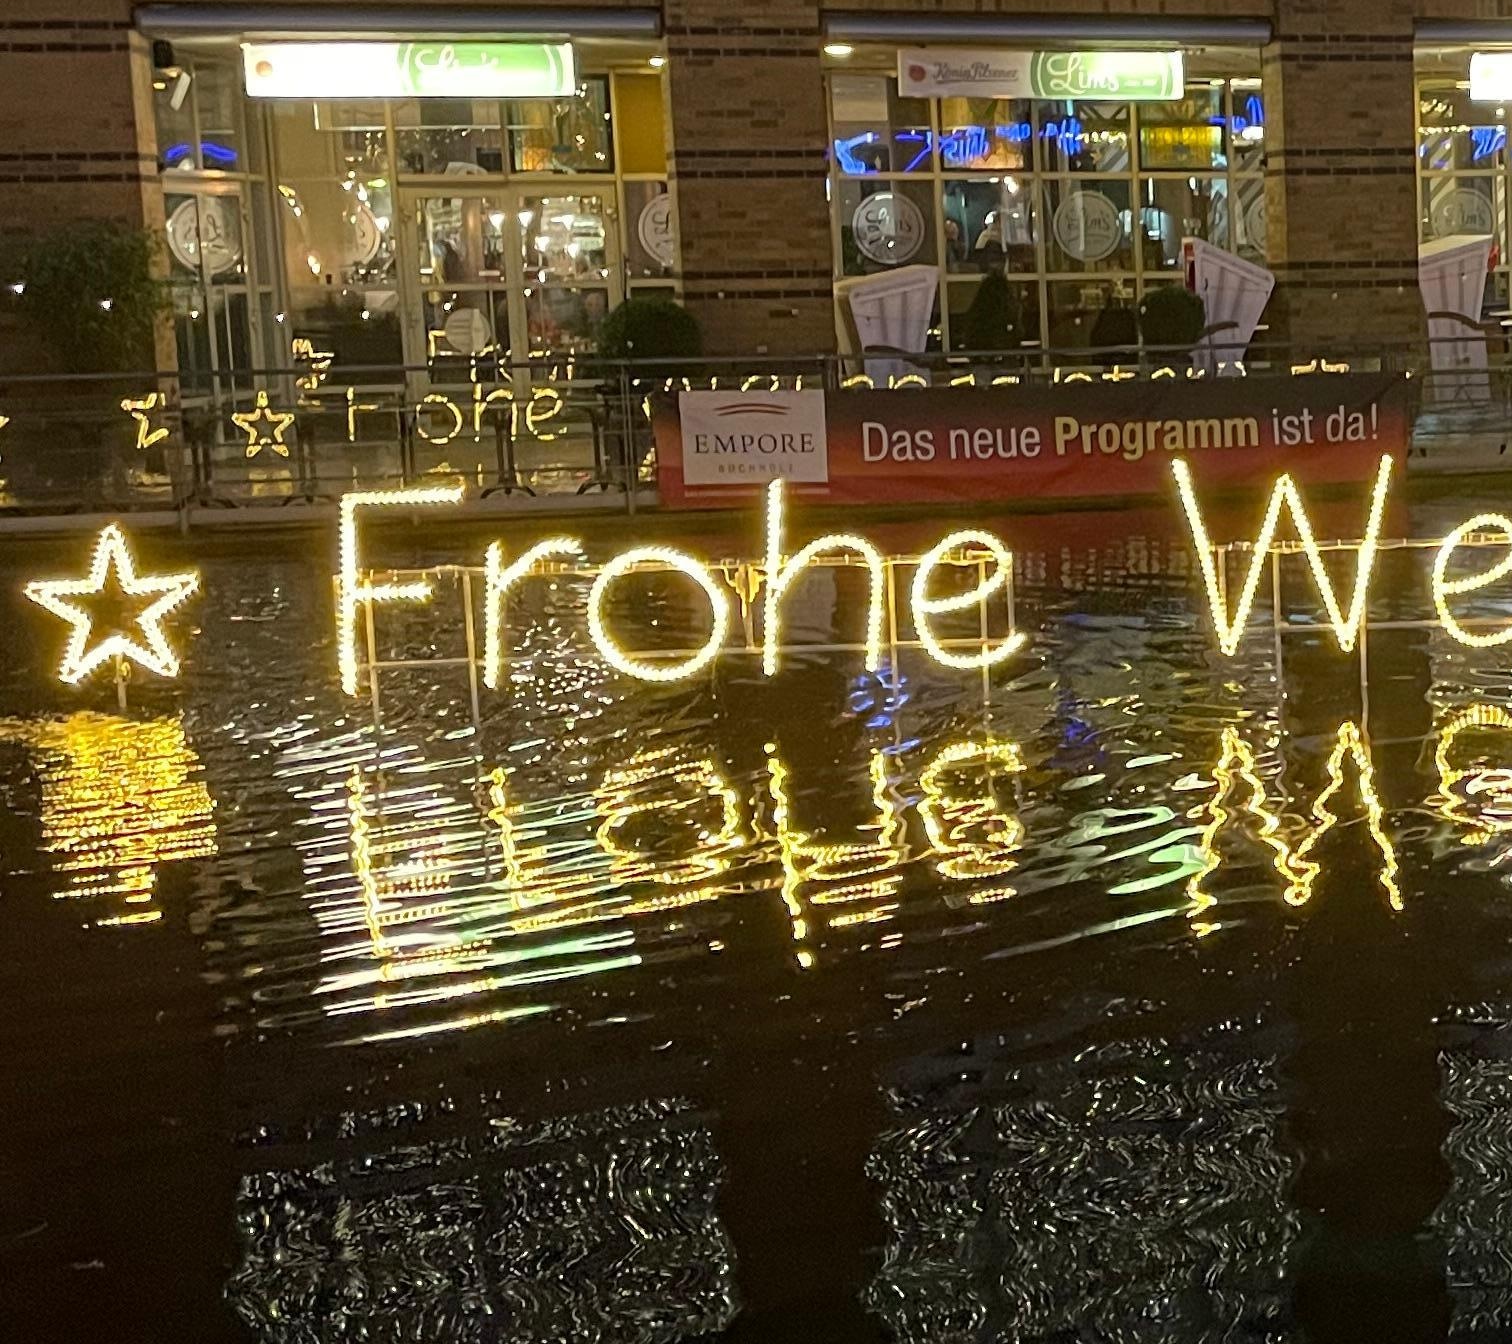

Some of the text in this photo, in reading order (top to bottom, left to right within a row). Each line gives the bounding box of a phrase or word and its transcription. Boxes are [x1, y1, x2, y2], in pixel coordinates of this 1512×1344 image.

[694, 432, 815, 455] EMPORE
[862, 403, 1379, 463] Das neue Programm ist da!
[334, 477, 1029, 696] Frohe
